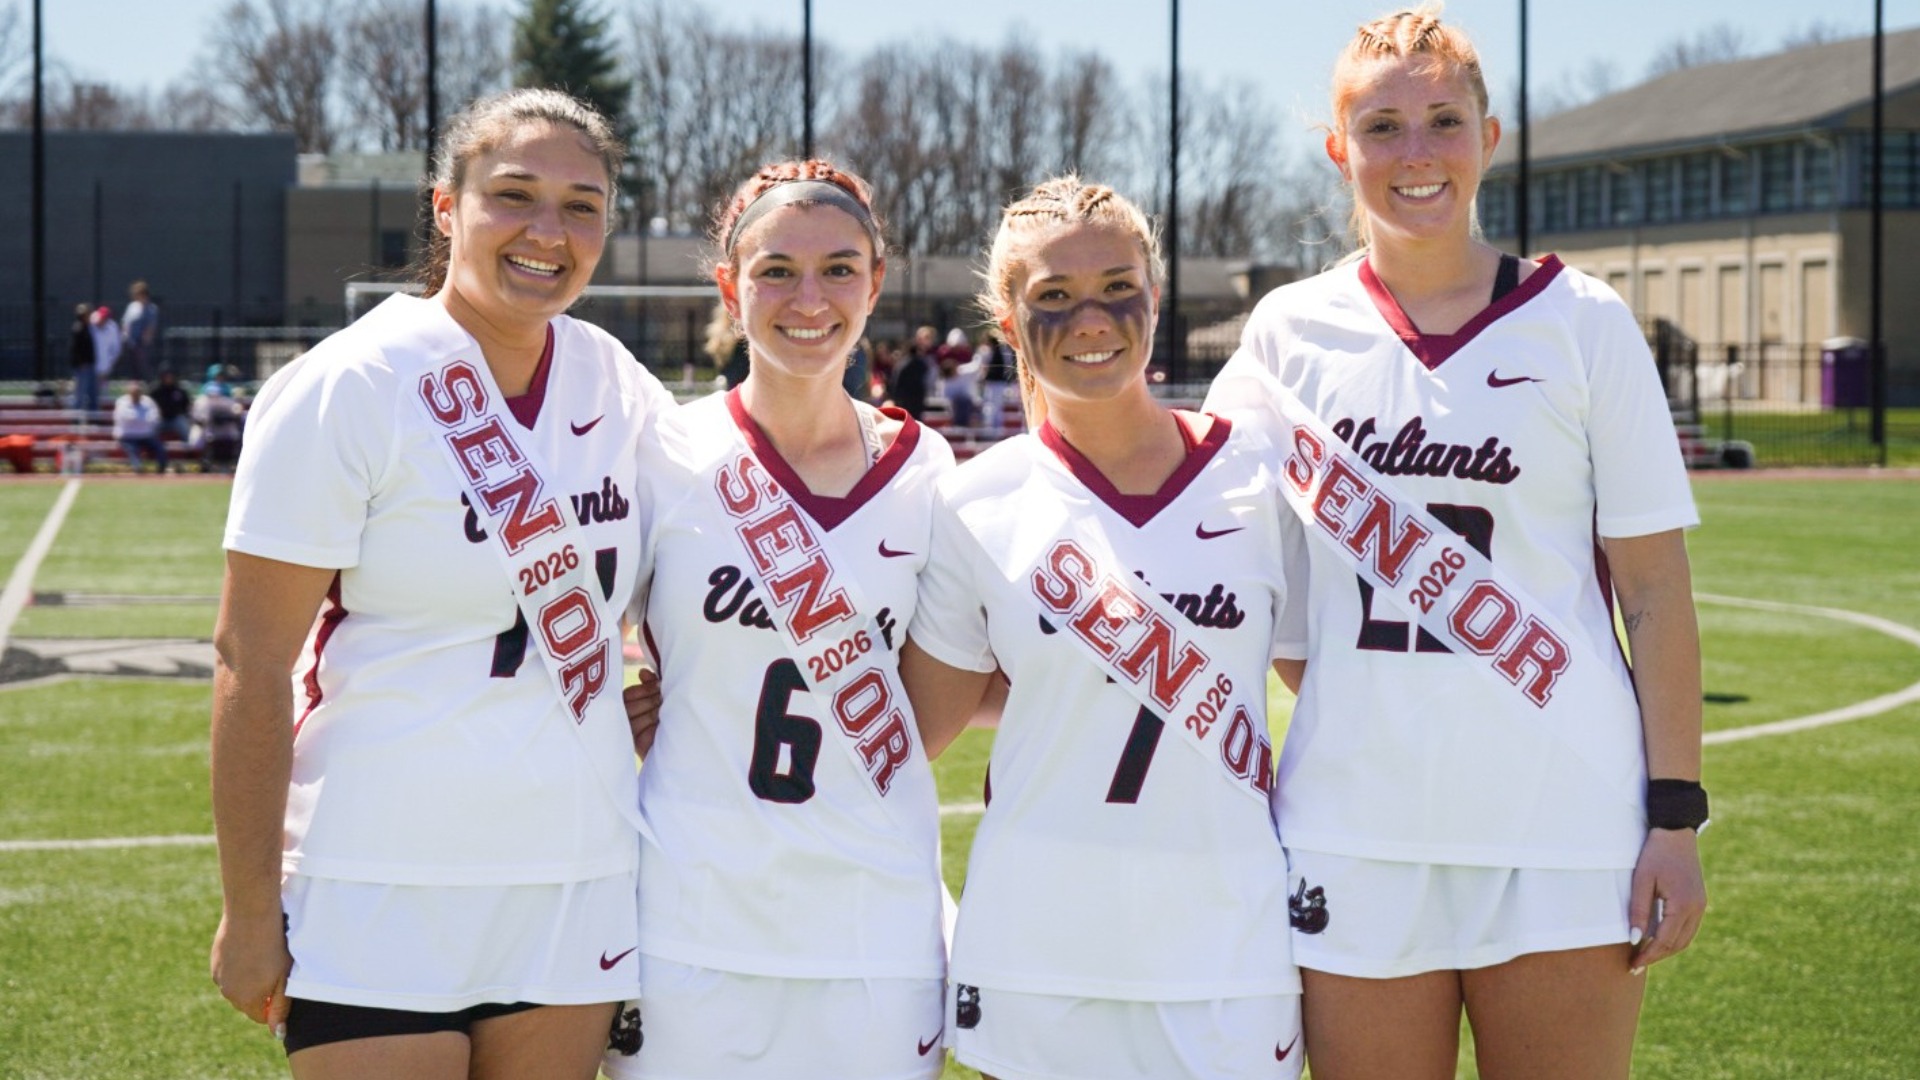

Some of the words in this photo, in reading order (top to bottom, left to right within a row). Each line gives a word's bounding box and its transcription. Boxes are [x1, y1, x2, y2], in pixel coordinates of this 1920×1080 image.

[518, 544, 579, 596] 2026
[1409, 547, 1466, 614] 2026
[808, 630, 872, 682] 2026
[749, 658, 822, 804] 6
[1185, 673, 1233, 740] 2026
